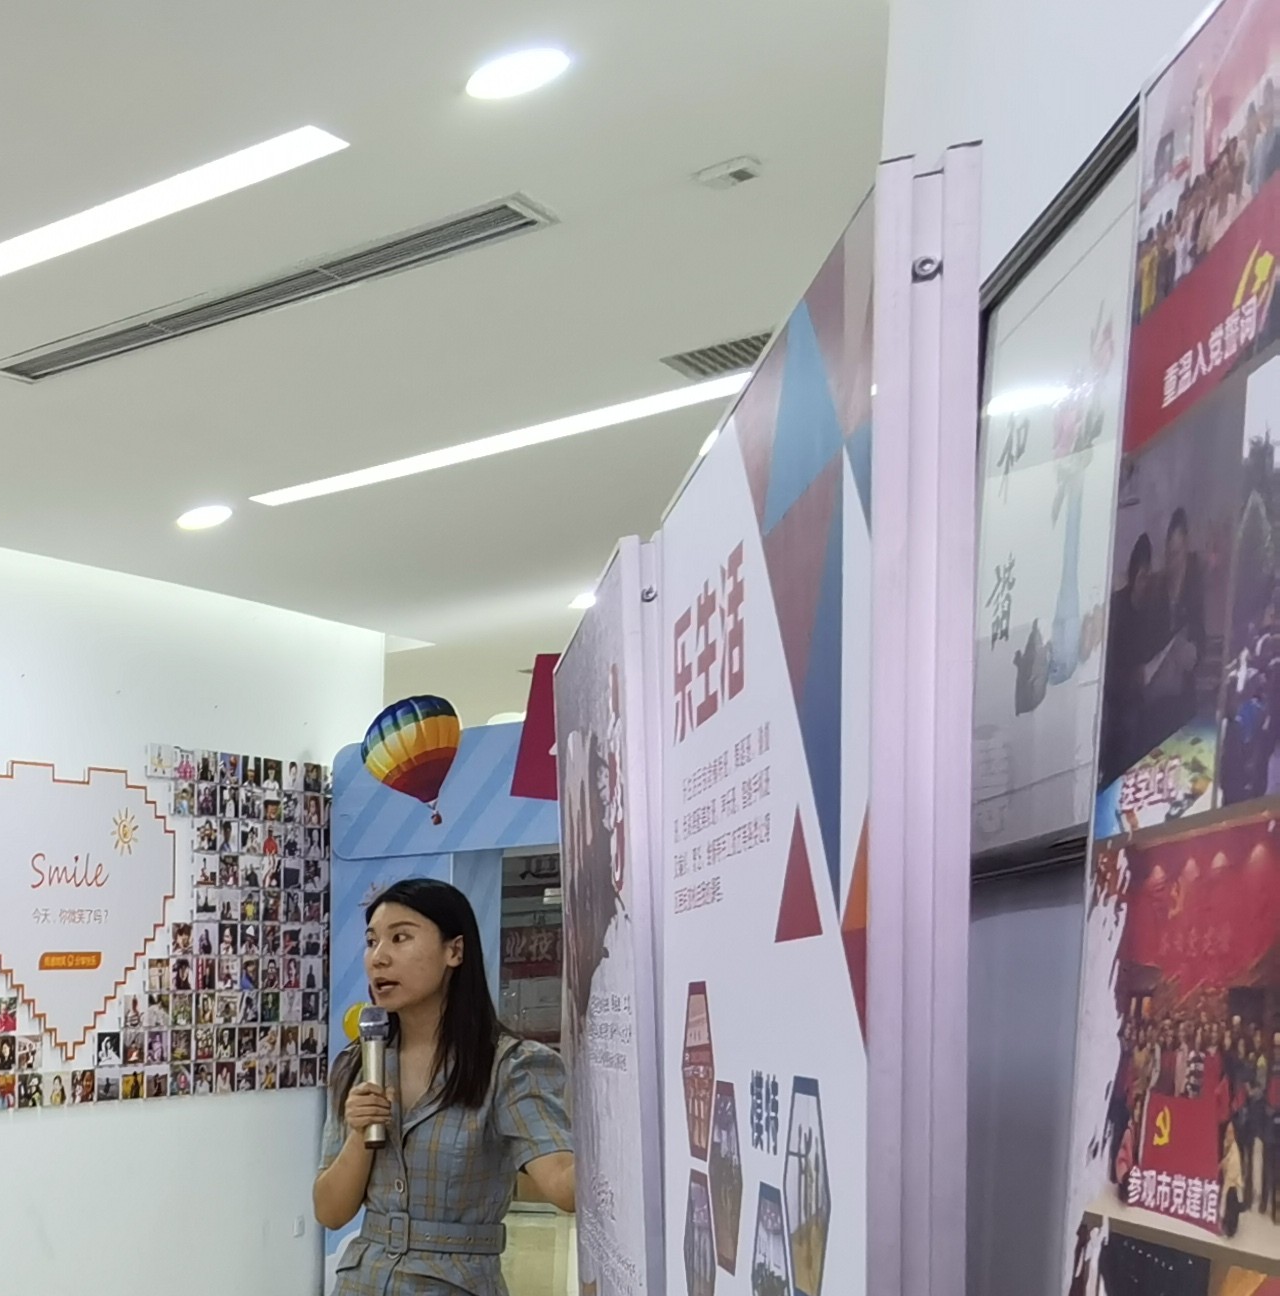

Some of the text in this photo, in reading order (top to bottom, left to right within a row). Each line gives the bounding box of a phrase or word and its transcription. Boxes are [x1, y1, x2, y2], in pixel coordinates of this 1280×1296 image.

[673, 539, 745, 747] 乐生活
[31, 853, 109, 888] Smile
[1127, 1165, 1219, 1224] 参观市党建馆
